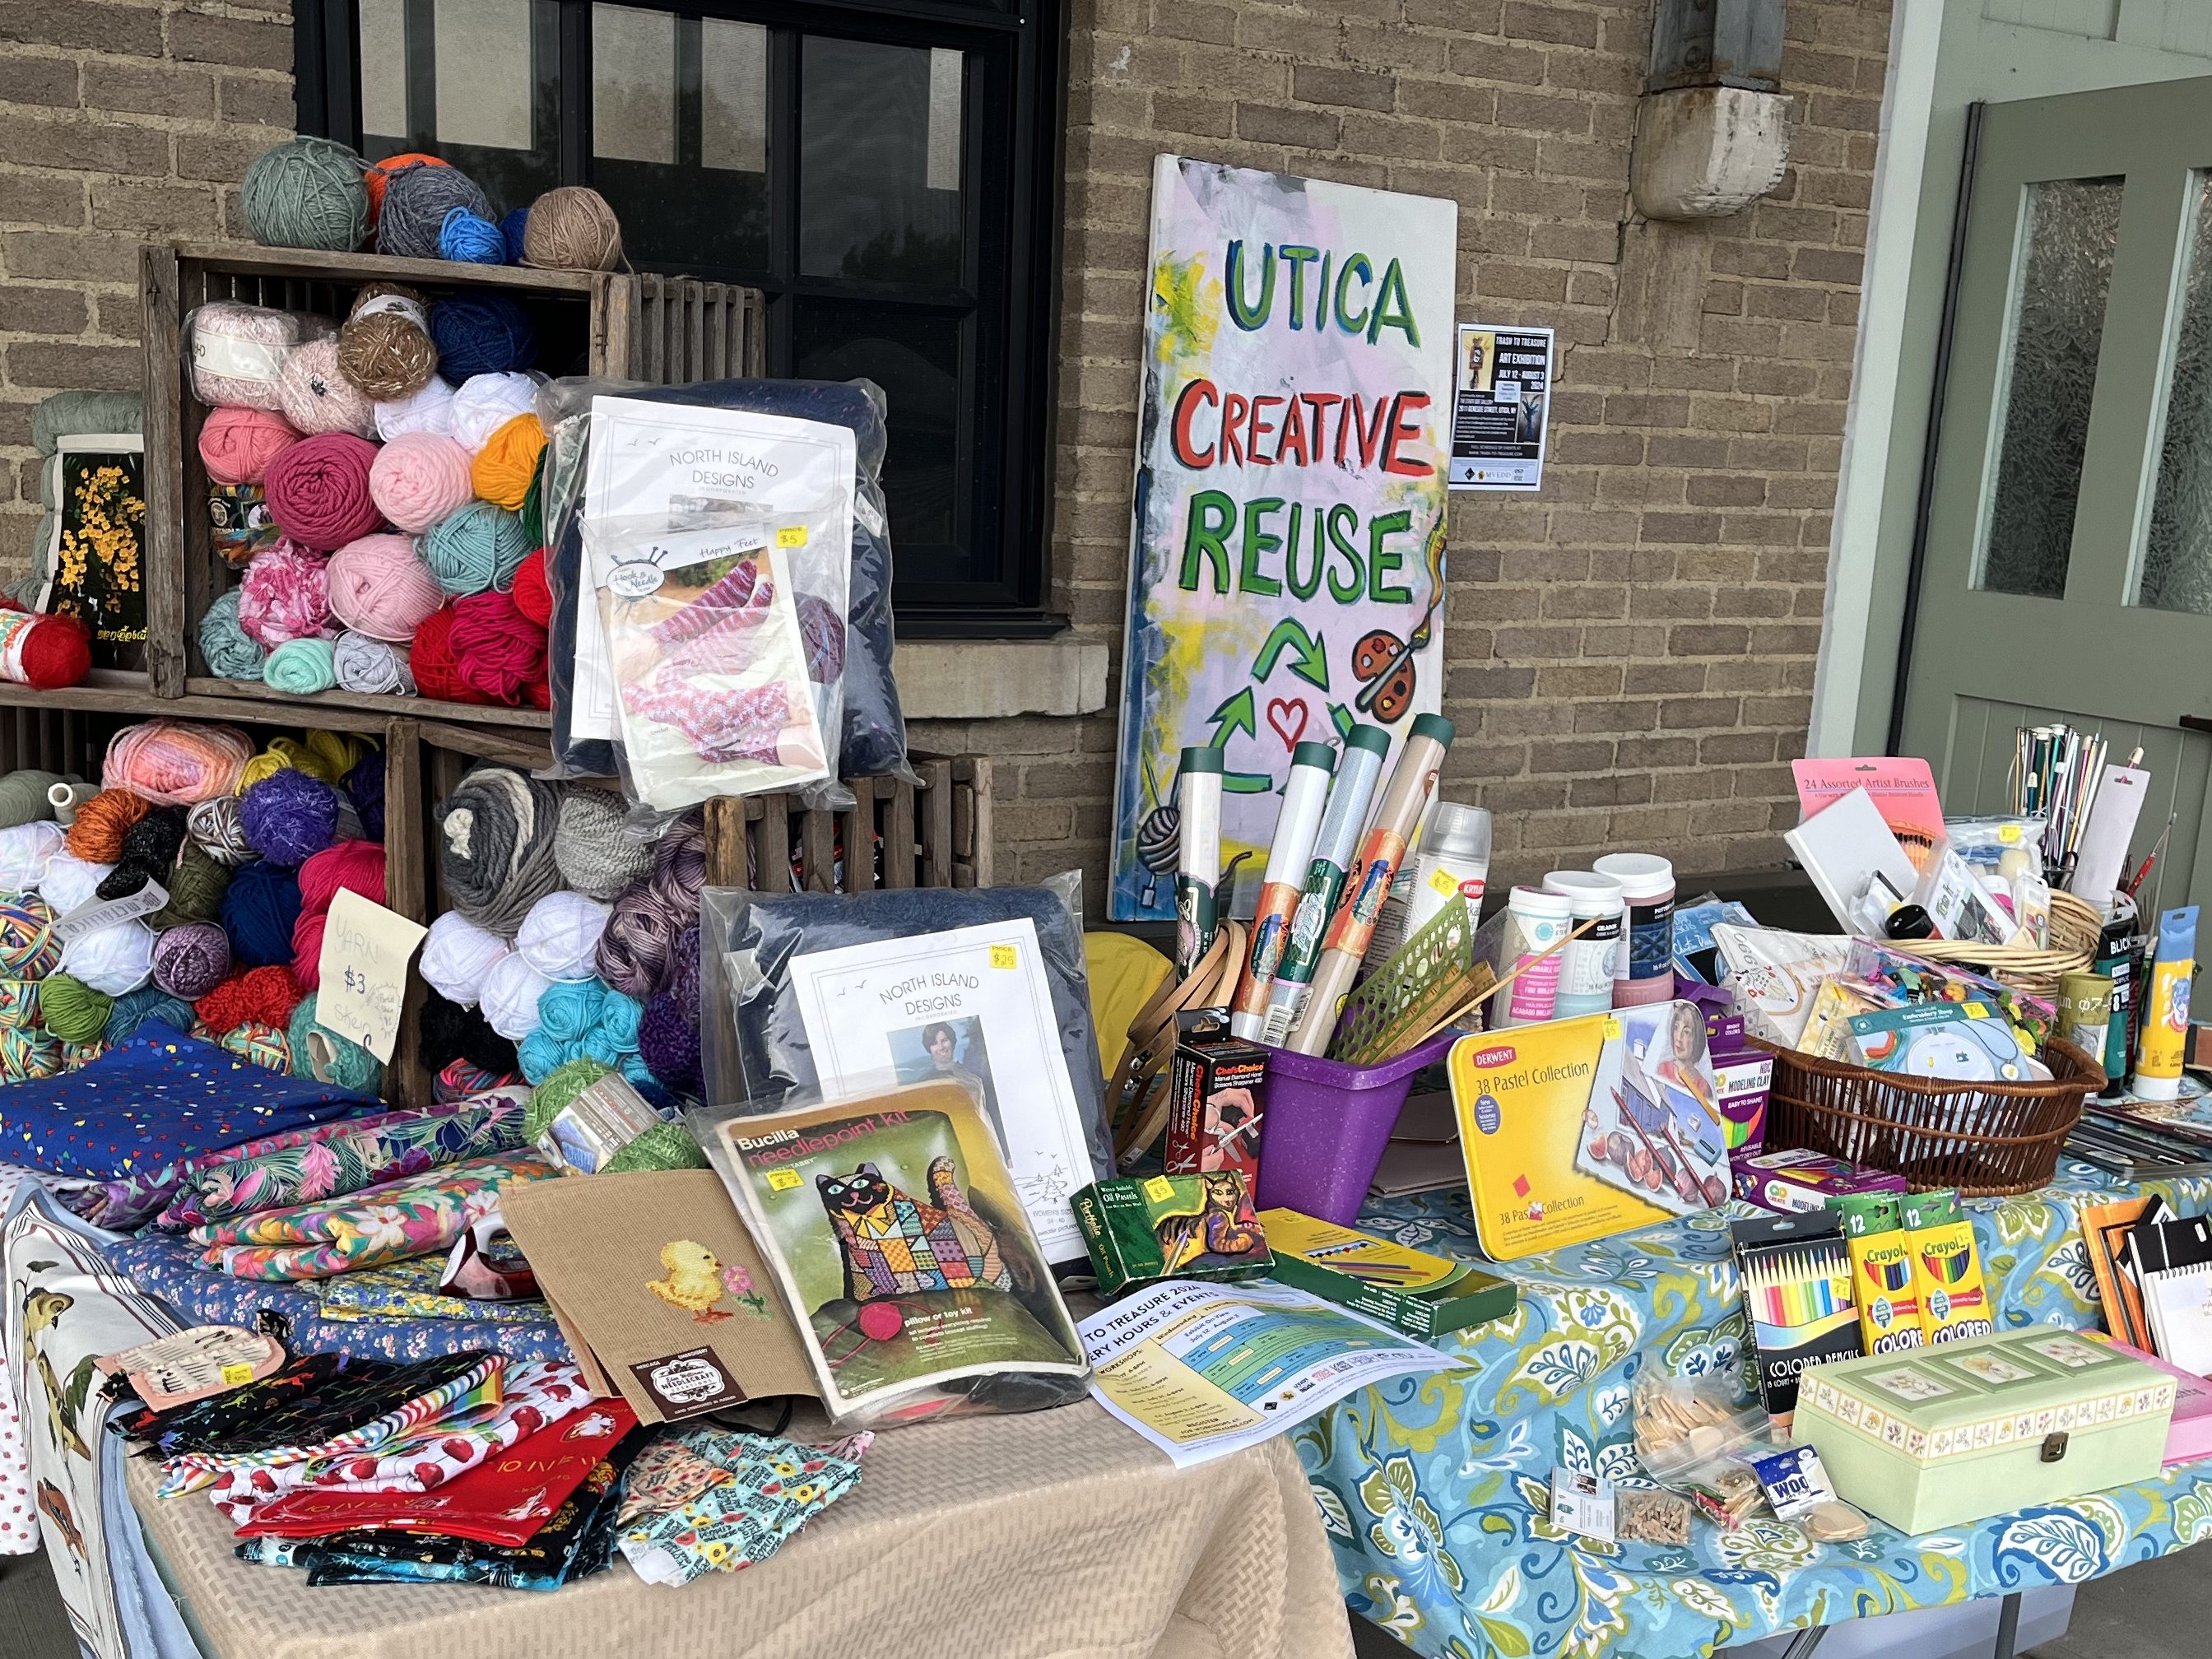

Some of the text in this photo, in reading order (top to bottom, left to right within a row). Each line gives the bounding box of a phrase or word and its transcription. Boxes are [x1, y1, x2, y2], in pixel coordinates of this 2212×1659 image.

[1225, 239, 1420, 348] UTICA
[1522, 337, 1546, 347] TREASURE
[1499, 353, 1545, 365] ART EXHIBITION
[1499, 369, 1511, 379] JULY
[1512, 370, 1518, 379] 12
[1172, 379, 1435, 476] CREATIVE
[669, 450, 778, 477] NORTH ISLAND
[692, 470, 754, 488] DESIGNS
[699, 537, 759, 559] Happy Feet
[780, 534, 797, 545] $5
[1178, 489, 1413, 604] REUSE
[631, 574, 658, 588] Needle
[1805, 778, 1930, 790] 24 Assorted Artist Brushes
[65, 901, 141, 934] METALLICA
[333, 913, 379, 964] YARN
[2110, 936, 2131, 955] BLICK
[992, 953, 1014, 966] $25
[344, 965, 365, 994] $3
[880, 973, 979, 1004] NORTH ISLAND
[905, 993, 962, 1015] DESIGNS
[1903, 1010, 1937, 1020] Embroidery
[1476, 1049, 1513, 1066] DERWENT
[1233, 1079, 1254, 1087] Sharpener
[1476, 1062, 1590, 1095] 38 Pastel Collection
[1728, 1075, 1771, 1093] MODELING CLAY
[1728, 1100, 1740, 1108] EASY
[737, 1128, 800, 1151] Bucilla
[748, 1108, 911, 1168] needlepoint kit
[1154, 1185, 1167, 1198] $5
[1500, 1211, 1510, 1225] 38
[1542, 1196, 1585, 1215] Collection
[1907, 1209, 1922, 1227] 12
[1850, 1215, 1866, 1233] 12
[904, 1315, 931, 1327] pillow
[943, 1310, 959, 1320] toy
[960, 1307, 973, 1315] kit
[1085, 1285, 1201, 1342] TO TREASURE 2024
[1115, 1291, 1220, 1346] HOURS & EVENTS
[1184, 1312, 1230, 1337] Exhibit On View
[1156, 1314, 1197, 1340] Wednesday
[1189, 1332, 1201, 1343] July
[1213, 1317, 1235, 1329] August
[1932, 1320, 1991, 1345] COLORED
[1098, 1349, 1144, 1375] WORKSHOPS:
[1770, 1355, 1823, 1377] COLORED
[661, 1372, 714, 1390] NEEDLECRAFT
[672, 1378, 713, 1392] CREATIONS
[1186, 1417, 1220, 1428] REGISTER
[1773, 1475, 1809, 1498] WOO
